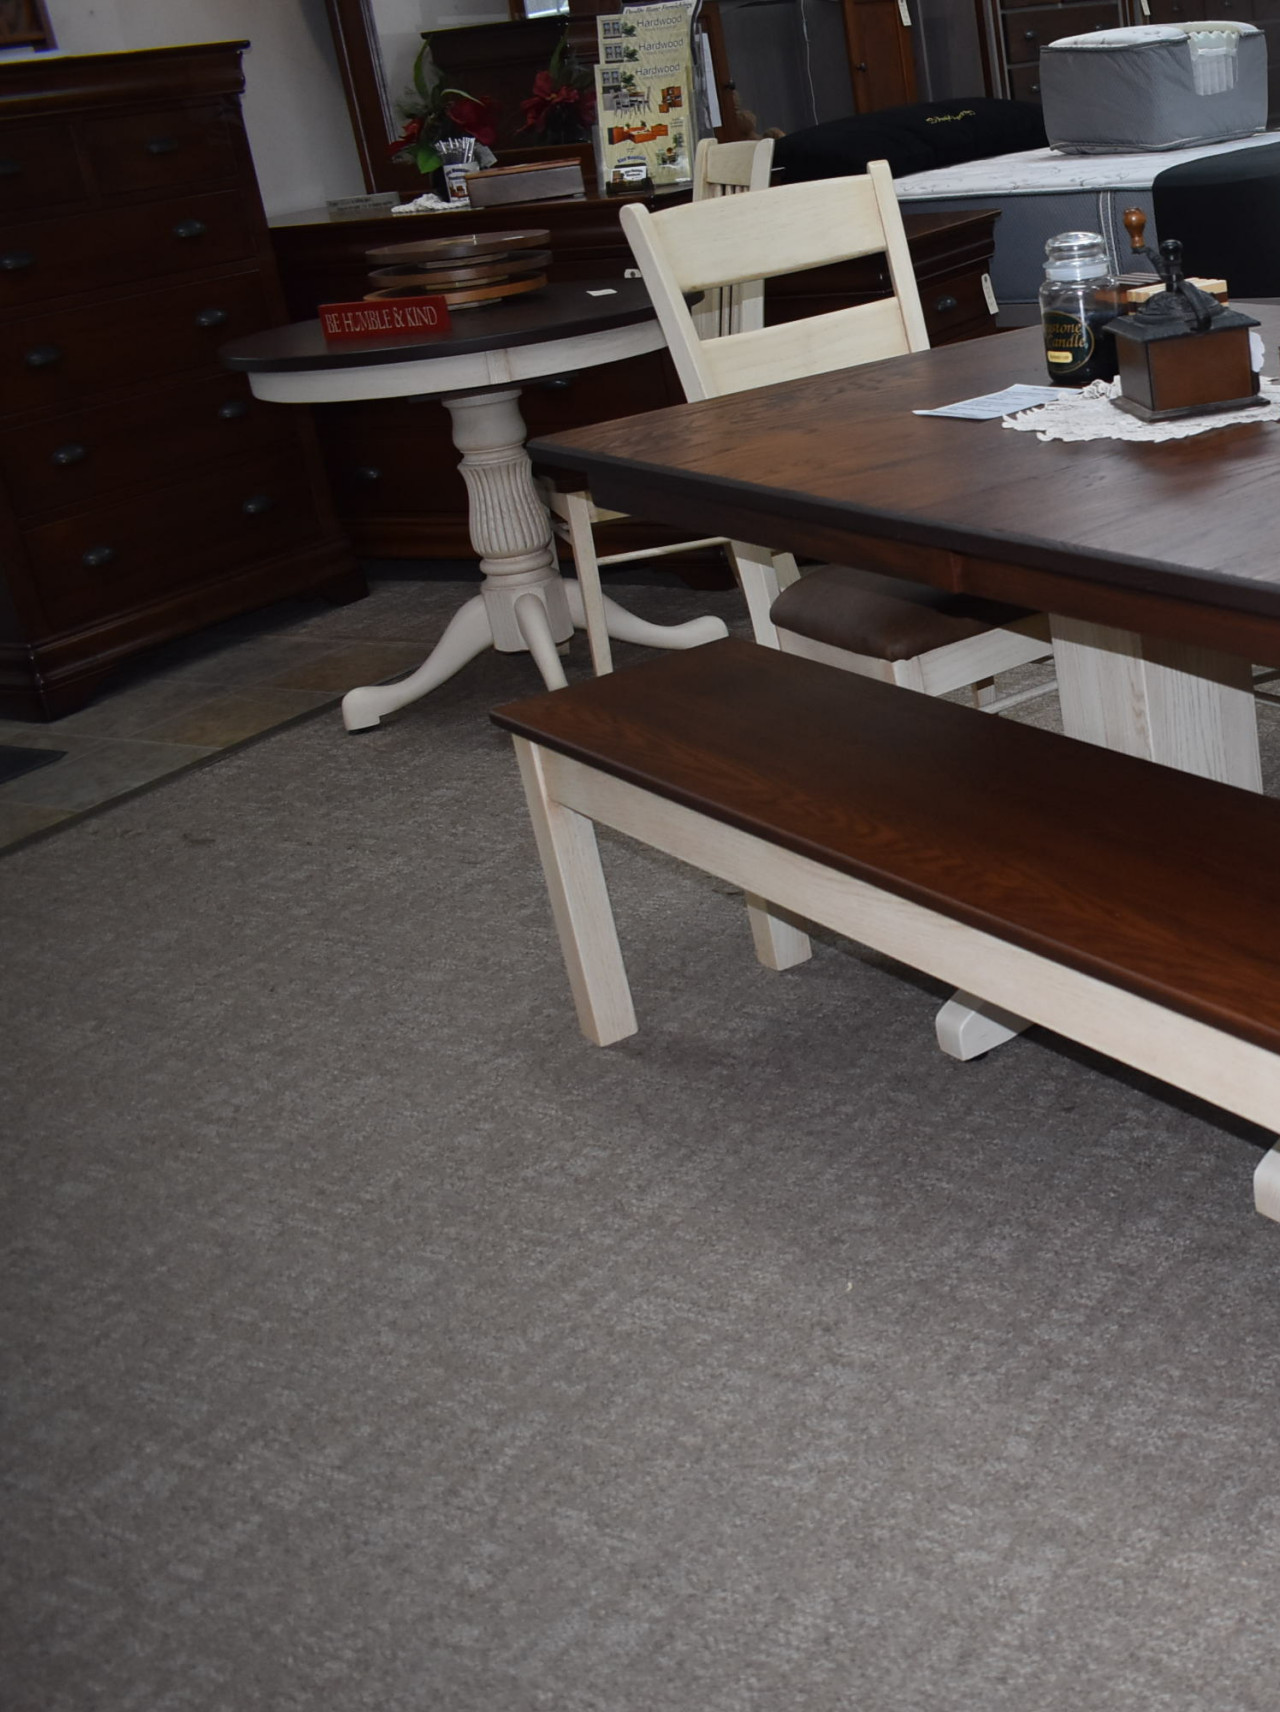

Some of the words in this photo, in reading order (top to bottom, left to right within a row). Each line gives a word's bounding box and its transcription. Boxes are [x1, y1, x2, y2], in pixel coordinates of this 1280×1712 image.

[637, 15, 682, 27] Hardwood
[638, 39, 684, 51] Hardwood
[635, 63, 680, 75] Hardwood
[325, 313, 341, 333] BE
[342, 309, 392, 332] HUMBLE
[393, 307, 405, 328] &
[405, 306, 438, 327] KIND
